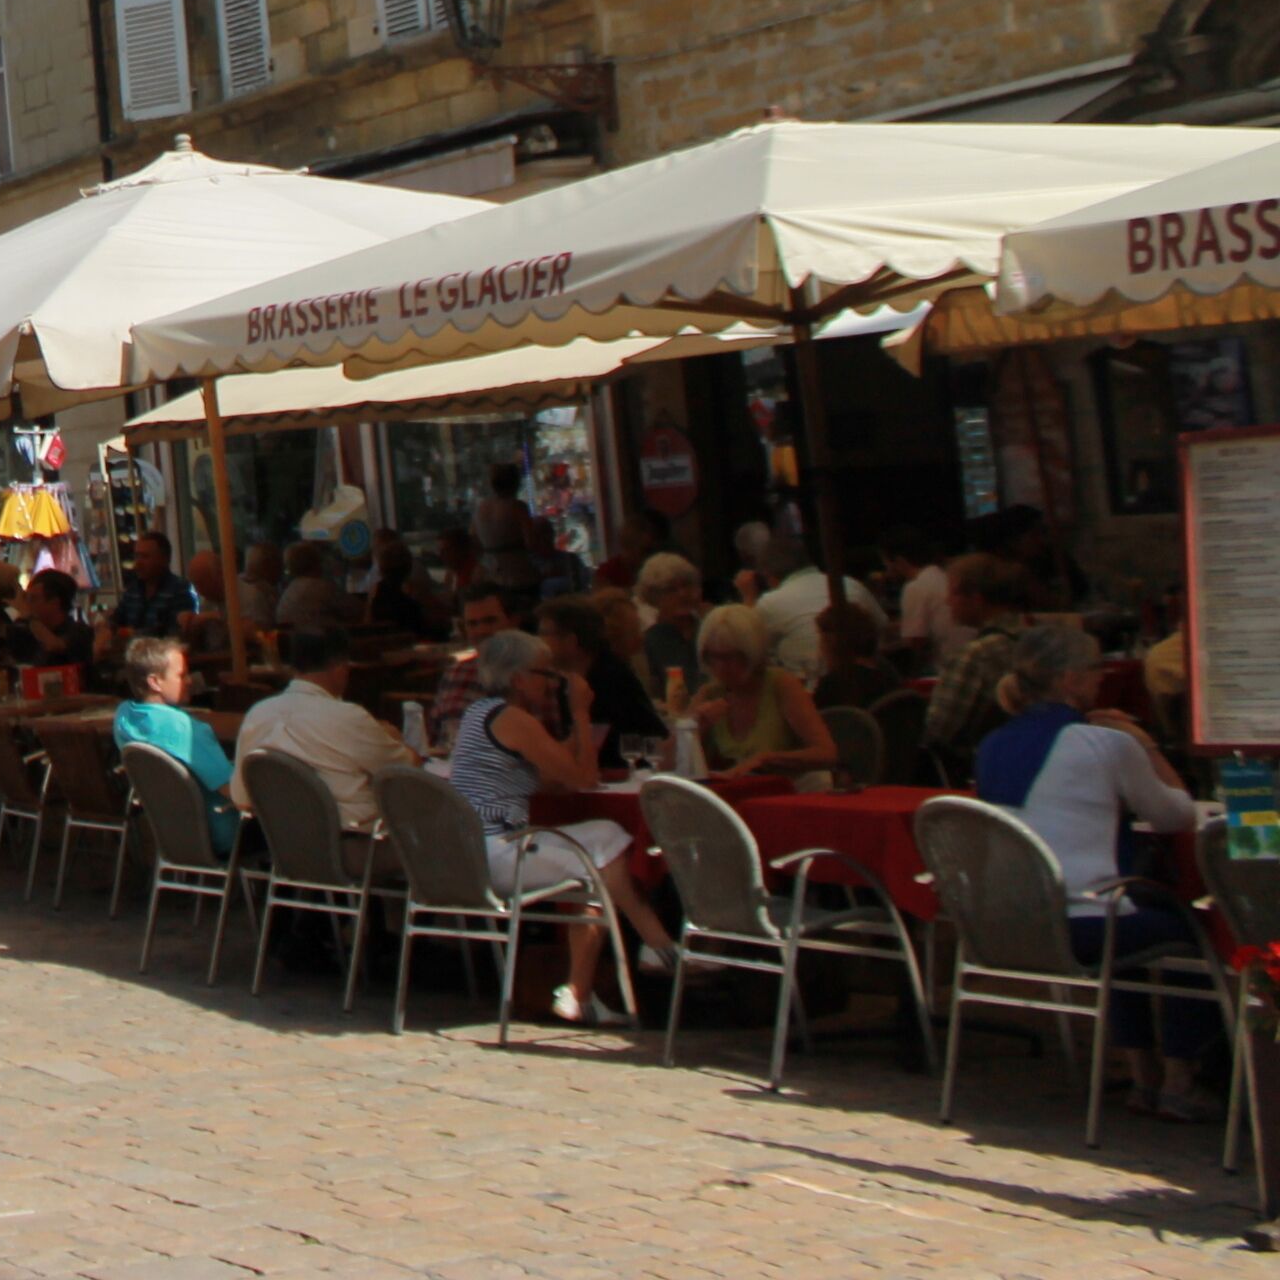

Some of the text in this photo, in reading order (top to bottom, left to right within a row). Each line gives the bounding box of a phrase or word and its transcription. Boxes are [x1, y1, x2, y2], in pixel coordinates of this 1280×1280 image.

[1128, 198, 1280, 275] BRASS
[246, 252, 573, 344] BRASSERIE LE GLACIER
